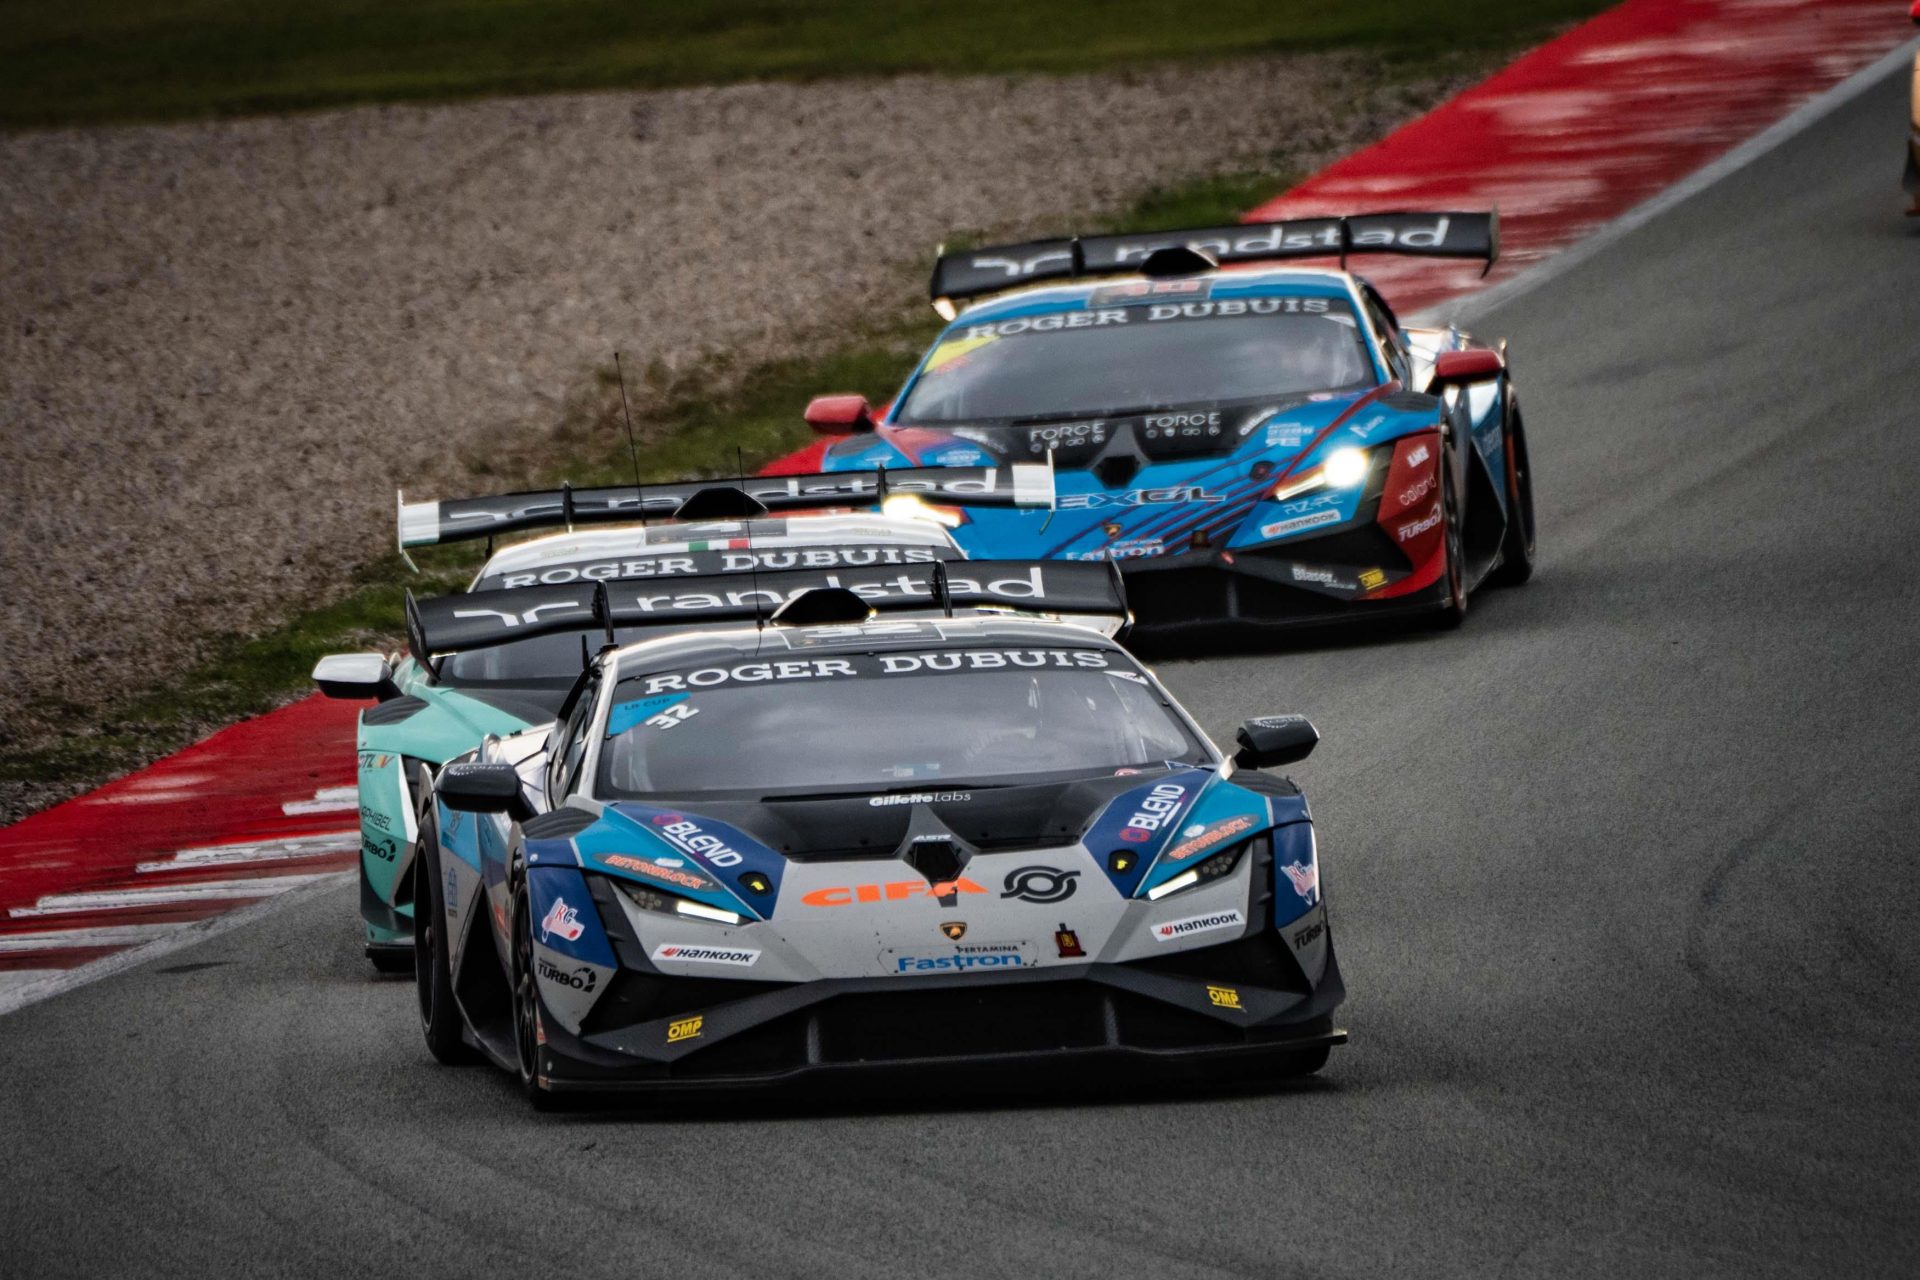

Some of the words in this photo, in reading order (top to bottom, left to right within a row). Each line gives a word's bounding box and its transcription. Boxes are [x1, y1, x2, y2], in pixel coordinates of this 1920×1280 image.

[966, 309, 1128, 340] ROGER
[1149, 298, 1329, 322] DUBUIS
[1030, 422, 1105, 442] FORCE
[1145, 412, 1221, 429] FORCE
[1398, 515, 1437, 542] TURBO
[503, 557, 698, 589] ROGER
[721, 548, 935, 571] DUBUIS
[644, 659, 857, 694] ROGER
[879, 651, 1109, 673] DUBUIS
[643, 697, 671, 708] CUP
[645, 703, 700, 730] 32
[1127, 784, 1186, 831] BLEND
[663, 821, 744, 868] BLEND
[801, 877, 990, 907] CIFA
[898, 953, 1022, 972] Fastron
[957, 945, 1019, 954] PERTAMINA
[538, 963, 583, 990] TURBO
[1208, 989, 1239, 1006] OMP
[668, 1019, 702, 1040] OMP
